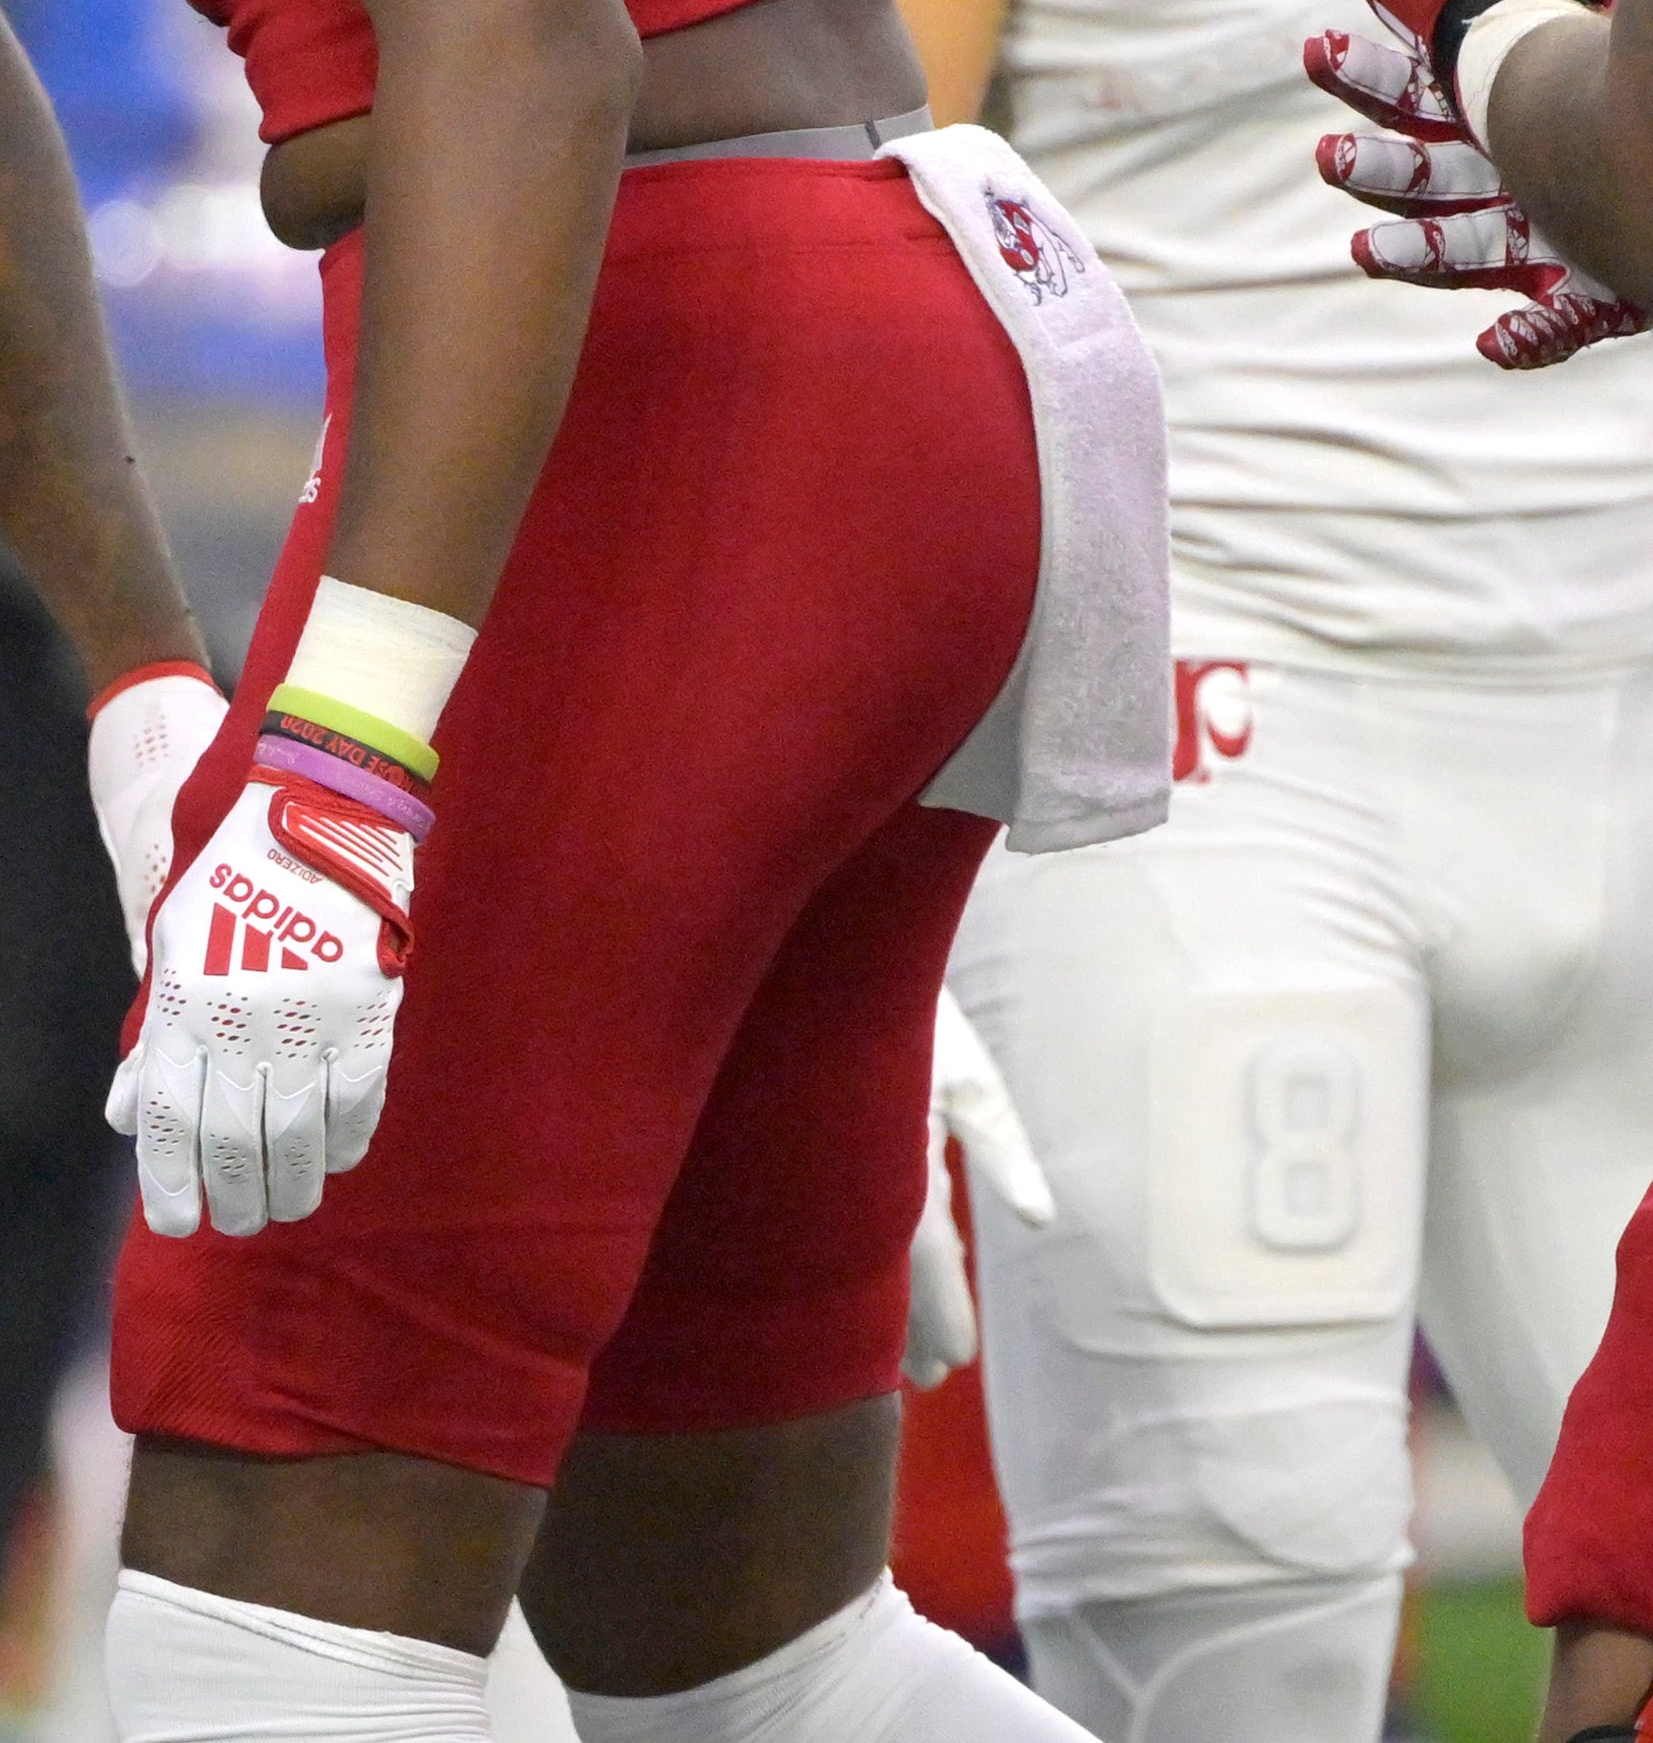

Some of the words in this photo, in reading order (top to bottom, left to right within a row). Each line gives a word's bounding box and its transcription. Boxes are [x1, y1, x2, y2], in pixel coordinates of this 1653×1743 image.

[279, 712, 325, 746] 2020
[324, 733, 368, 767] DAY
[266, 847, 325, 885] ADIZERO
[209, 862, 345, 964] adidas
